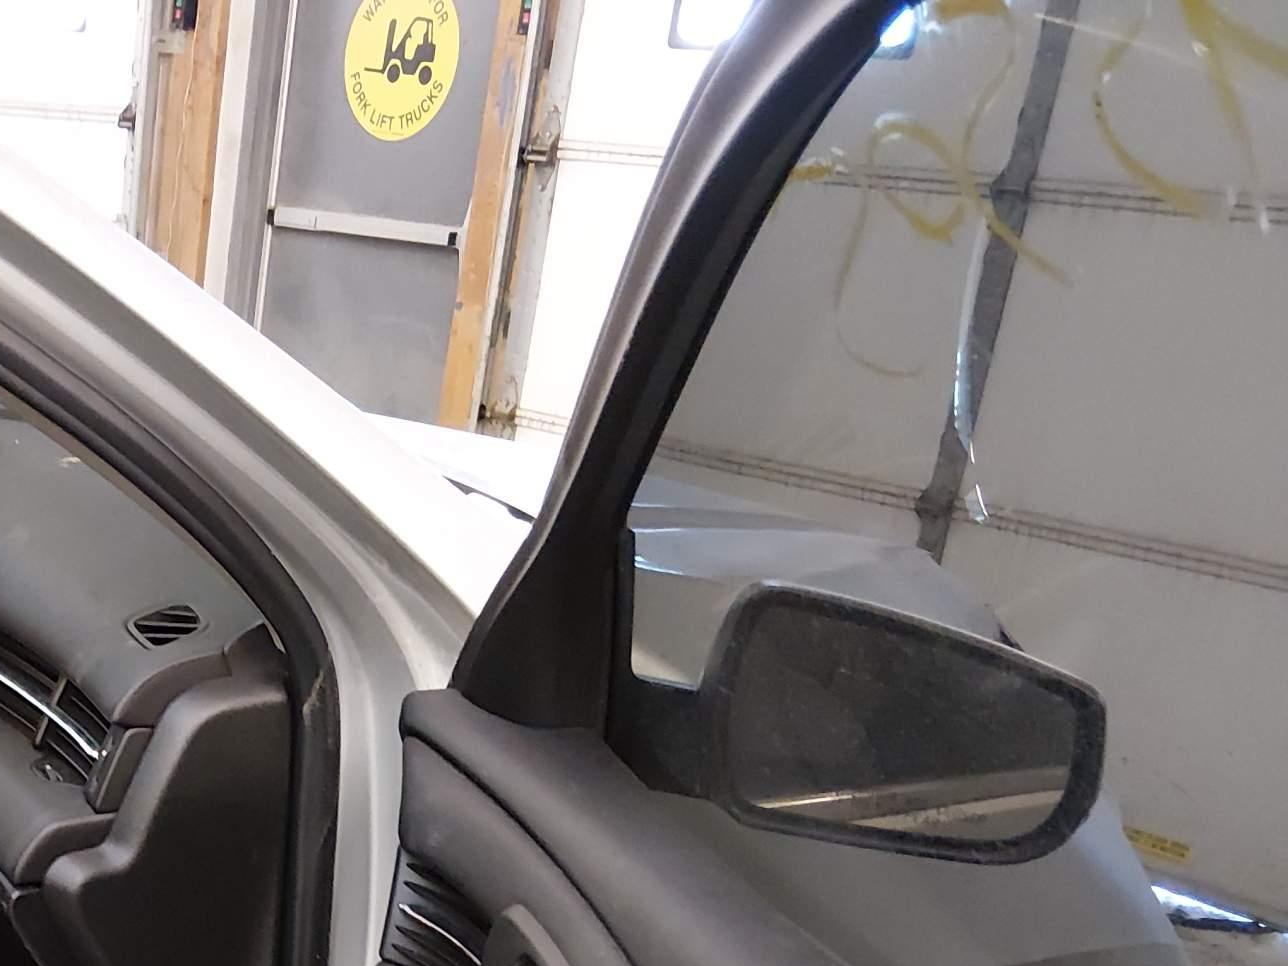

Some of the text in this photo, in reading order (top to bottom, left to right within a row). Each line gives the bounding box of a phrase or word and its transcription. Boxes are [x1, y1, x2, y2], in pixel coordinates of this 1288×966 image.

[350, 72, 443, 131] FORK LIFT TRUCKS
